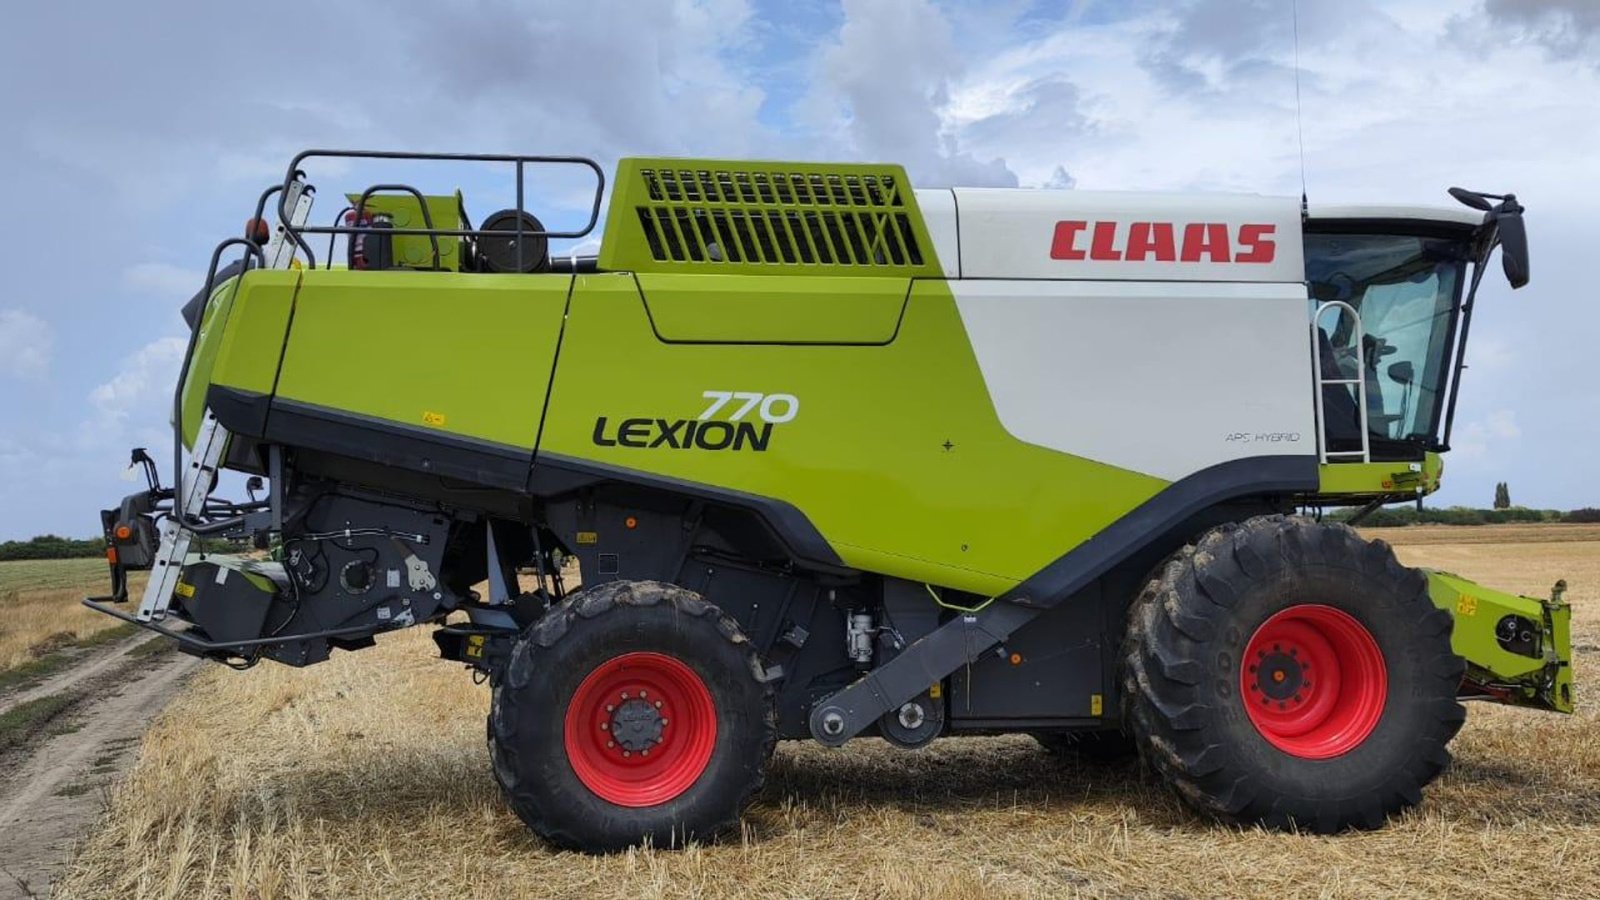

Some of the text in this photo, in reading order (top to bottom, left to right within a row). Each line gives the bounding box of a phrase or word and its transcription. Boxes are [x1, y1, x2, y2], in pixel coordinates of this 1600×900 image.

[1050, 220, 1276, 263] CLAAS
[698, 390, 799, 424] 770
[592, 416, 774, 452] LEXION
[1224, 431, 1301, 443] APS HYBRID
